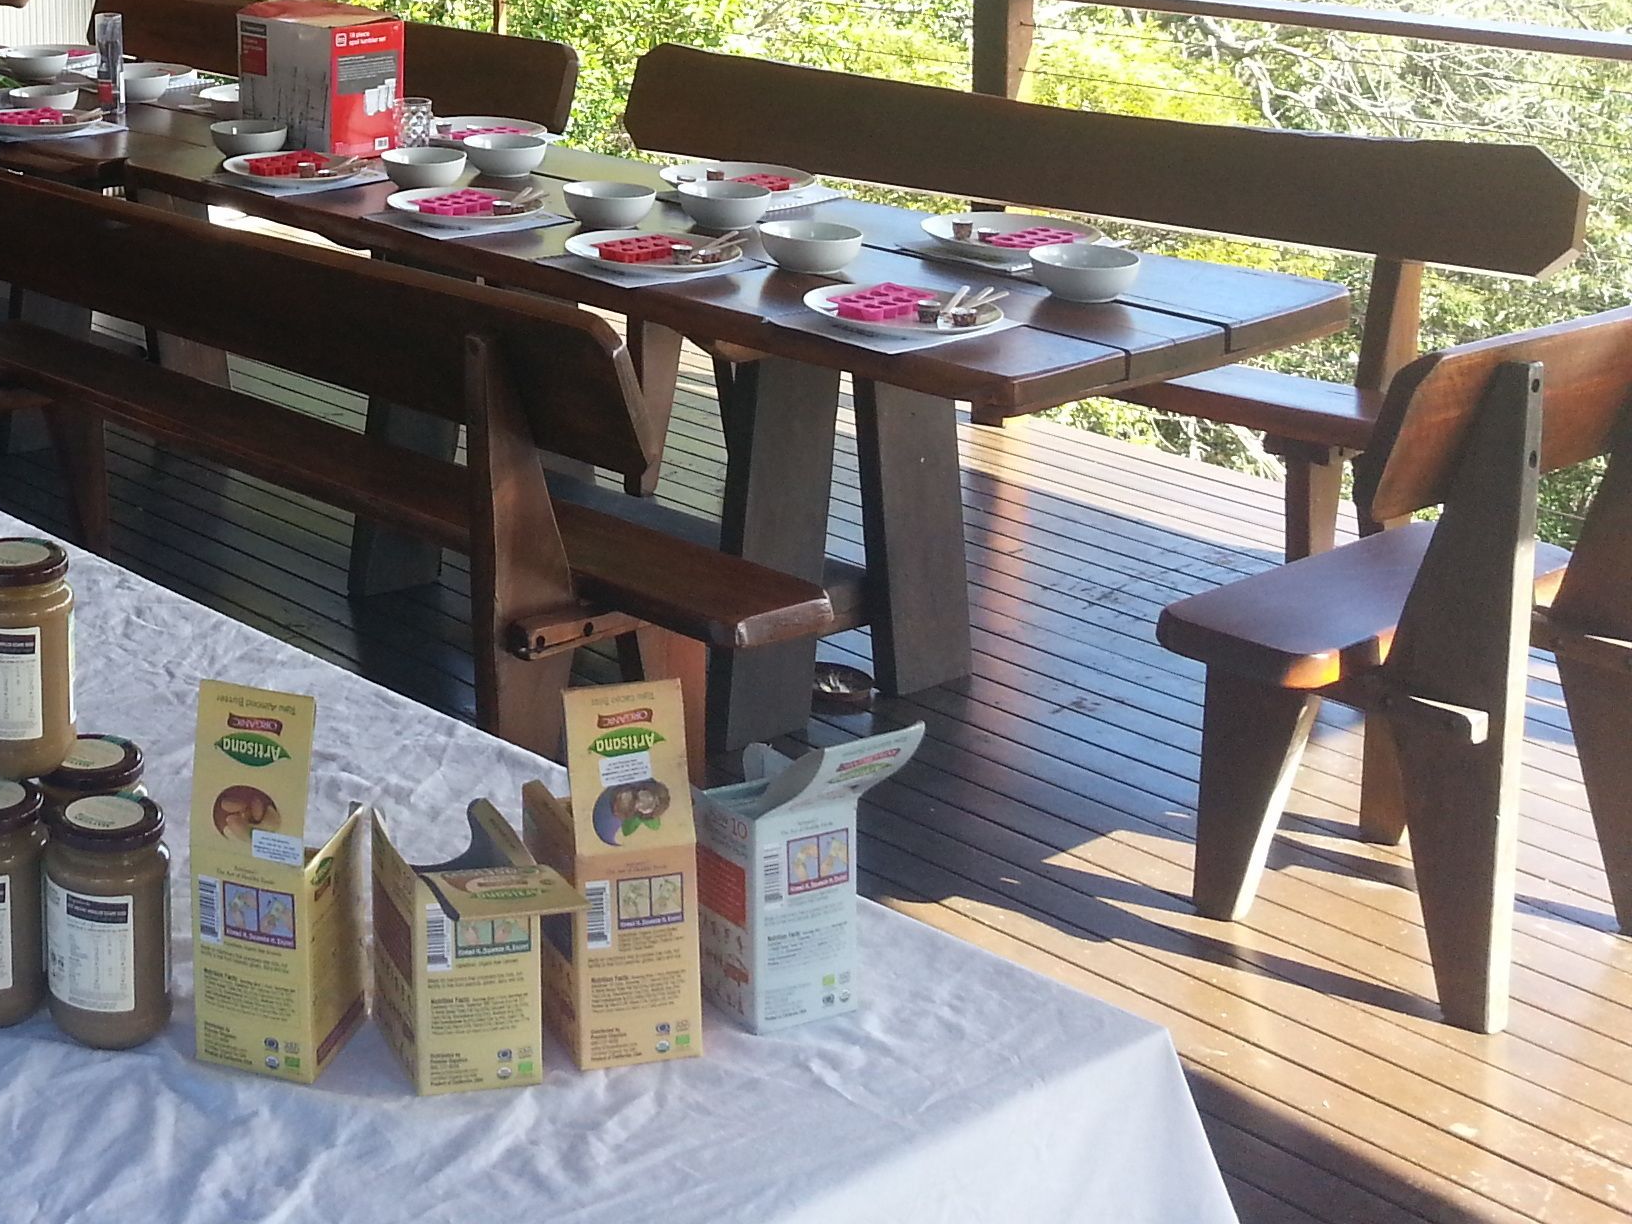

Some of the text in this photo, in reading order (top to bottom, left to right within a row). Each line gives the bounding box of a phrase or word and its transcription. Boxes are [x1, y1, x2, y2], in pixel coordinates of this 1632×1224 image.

[231, 717, 278, 731] ORGANIC
[602, 710, 648, 727] ORGANIC
[222, 737, 281, 761] Artisana
[595, 732, 655, 752] Artisana
[731, 817, 748, 839] 10
